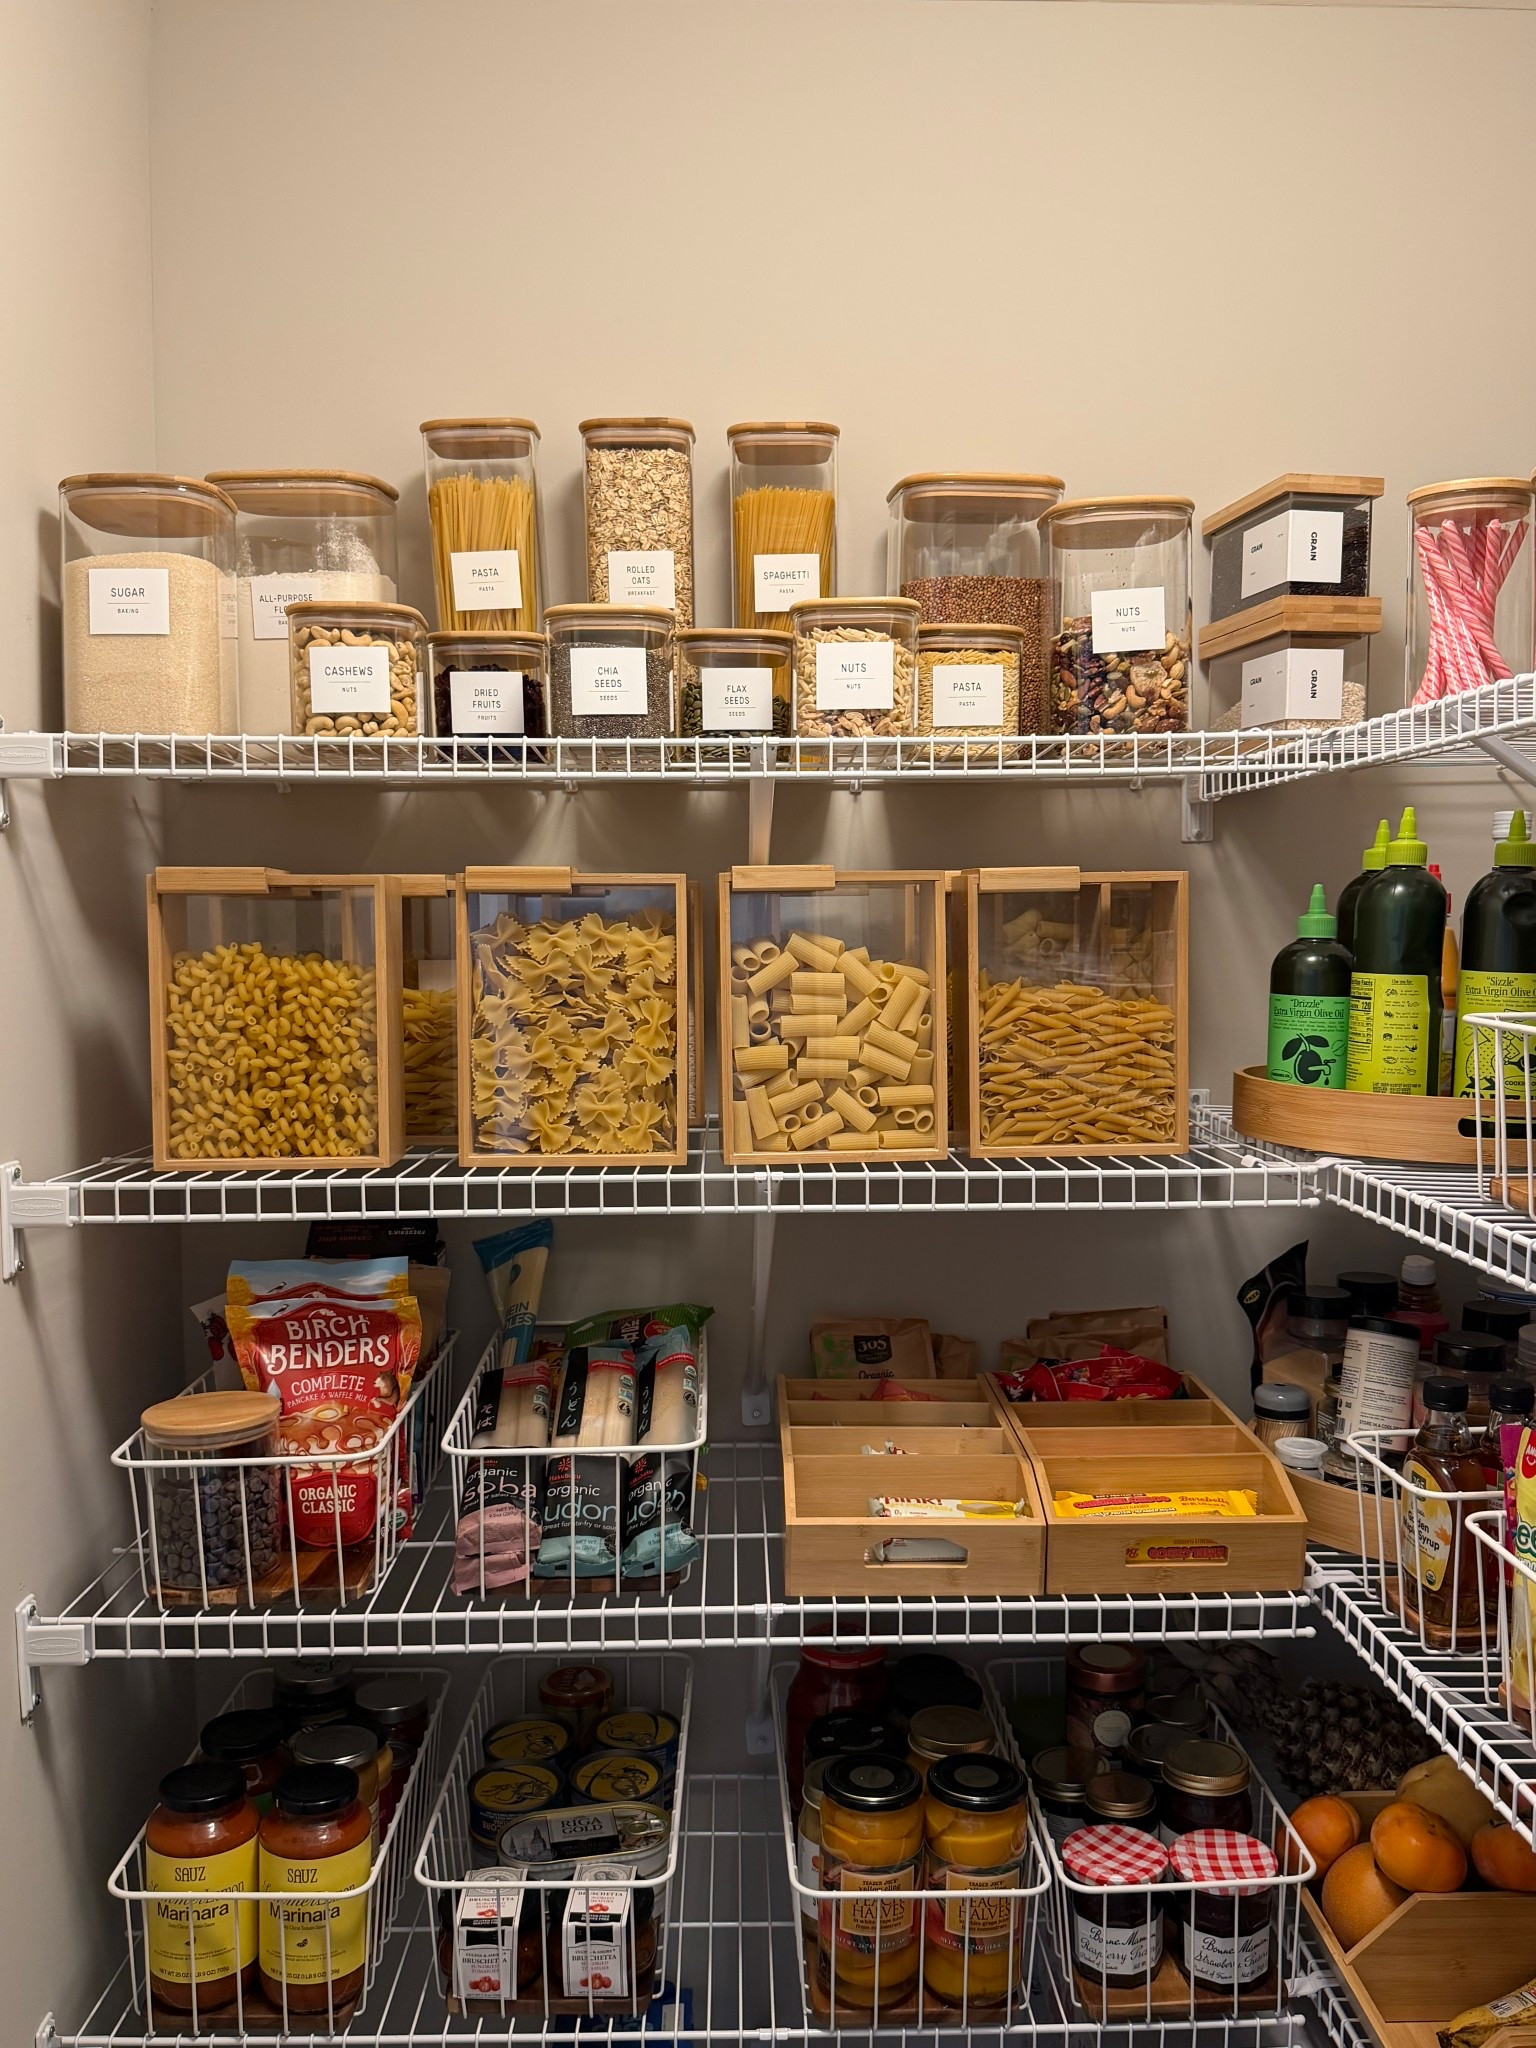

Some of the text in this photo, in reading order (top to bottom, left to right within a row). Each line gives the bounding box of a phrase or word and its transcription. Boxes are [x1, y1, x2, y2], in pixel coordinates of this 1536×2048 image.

[1250, 543, 1263, 554] GRAIN
[1310, 531, 1318, 561] GRAIN
[471, 568, 500, 578] PASTA
[626, 565, 655, 574] ROLLED
[763, 570, 810, 581] SPAGHETTI
[631, 576, 651, 585] OATS
[110, 587, 145, 598] SUGAR
[259, 594, 313, 602] ALL-PURPOSE
[1115, 607, 1141, 617] NUTS
[324, 666, 374, 676] CASHEWS
[597, 666, 619, 676] CHIA
[840, 663, 867, 673] NUTS
[594, 679, 622, 688] SEEDS
[953, 682, 982, 691] PASTA
[1250, 677, 1262, 685] GRAIN
[1310, 669, 1318, 699] GRAIN
[474, 688, 499, 697] DRIED
[726, 685, 747, 693] FLAX
[472, 700, 501, 709] FRUITS
[724, 696, 750, 705] SEEDS
[1465, 985, 1532, 998] Extra Virgin Olive
[1273, 1006, 1344, 1018] Extra Virgin Olive Oil
[285, 1314, 370, 1340] BIRCH
[267, 1334, 390, 1375] BENDERS
[291, 1374, 366, 1396] COMPLETE
[287, 1394, 319, 1408] PANCAKE
[328, 1391, 353, 1399] WAFFLE
[355, 1393, 368, 1402] MIX
[467, 1468, 518, 1483] organic
[298, 1484, 357, 1500] ORGANIC
[463, 1476, 536, 1503] soba
[547, 1484, 600, 1497] organic
[628, 1479, 672, 1501] organc
[301, 1499, 356, 1514] CLASSIC
[1179, 1495, 1230, 1505] Barebells
[544, 1494, 617, 1521] udon
[627, 1489, 686, 1525] udon
[1417, 1530, 1440, 1551] Syrup
[561, 1817, 602, 1828] RIGA
[562, 1824, 603, 1834] GOLD
[175, 1866, 206, 1882] SAUZ
[287, 1868, 318, 1884] SAUZ
[157, 1902, 229, 1921] Marinara
[269, 1902, 341, 1923] Marinara
[853, 1902, 905, 1919] HALVES
[958, 1903, 1010, 1920] HALVES
[1122, 1930, 1156, 1946] Mamn
[1202, 1937, 1267, 1955] Bonne Maman
[1210, 1971, 1215, 1979] of
